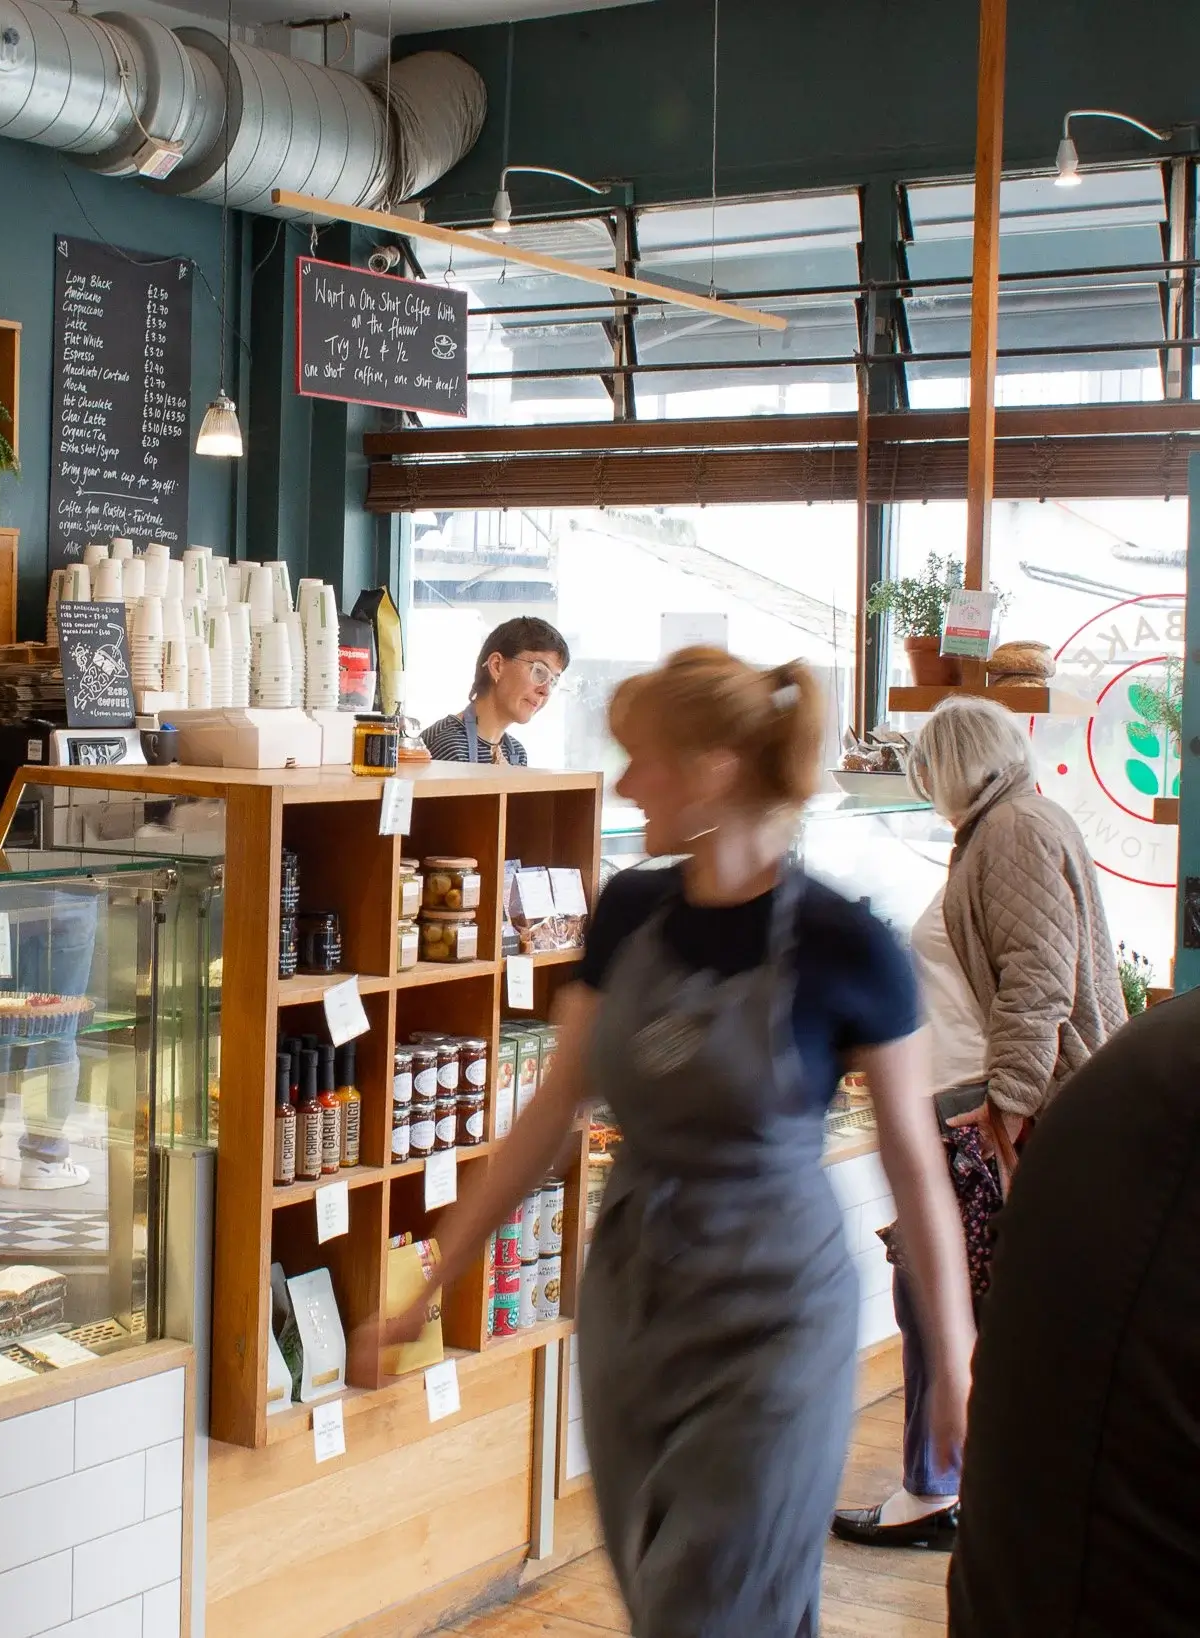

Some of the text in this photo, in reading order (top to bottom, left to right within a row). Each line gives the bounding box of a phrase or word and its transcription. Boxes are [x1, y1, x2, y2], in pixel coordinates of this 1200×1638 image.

[65, 269, 112, 291] Long Black
[64, 285, 102, 303] Americano
[315, 278, 345, 310] Want
[359, 288, 375, 311] One
[64, 316, 88, 331] Latte
[366, 313, 383, 336] the
[64, 332, 104, 349] Flat White
[324, 334, 349, 361] Try
[63, 347, 95, 363] Espresso
[63, 394, 75, 407] Hot
[61, 409, 106, 426] Chai Latte
[62, 425, 91, 442] Organic
[58, 498, 82, 517] Coffee
[322, 1109, 336, 1150] GARLIC
[346, 1101, 359, 1142] MANGO
[283, 1117, 295, 1160] CHIPOTLE
